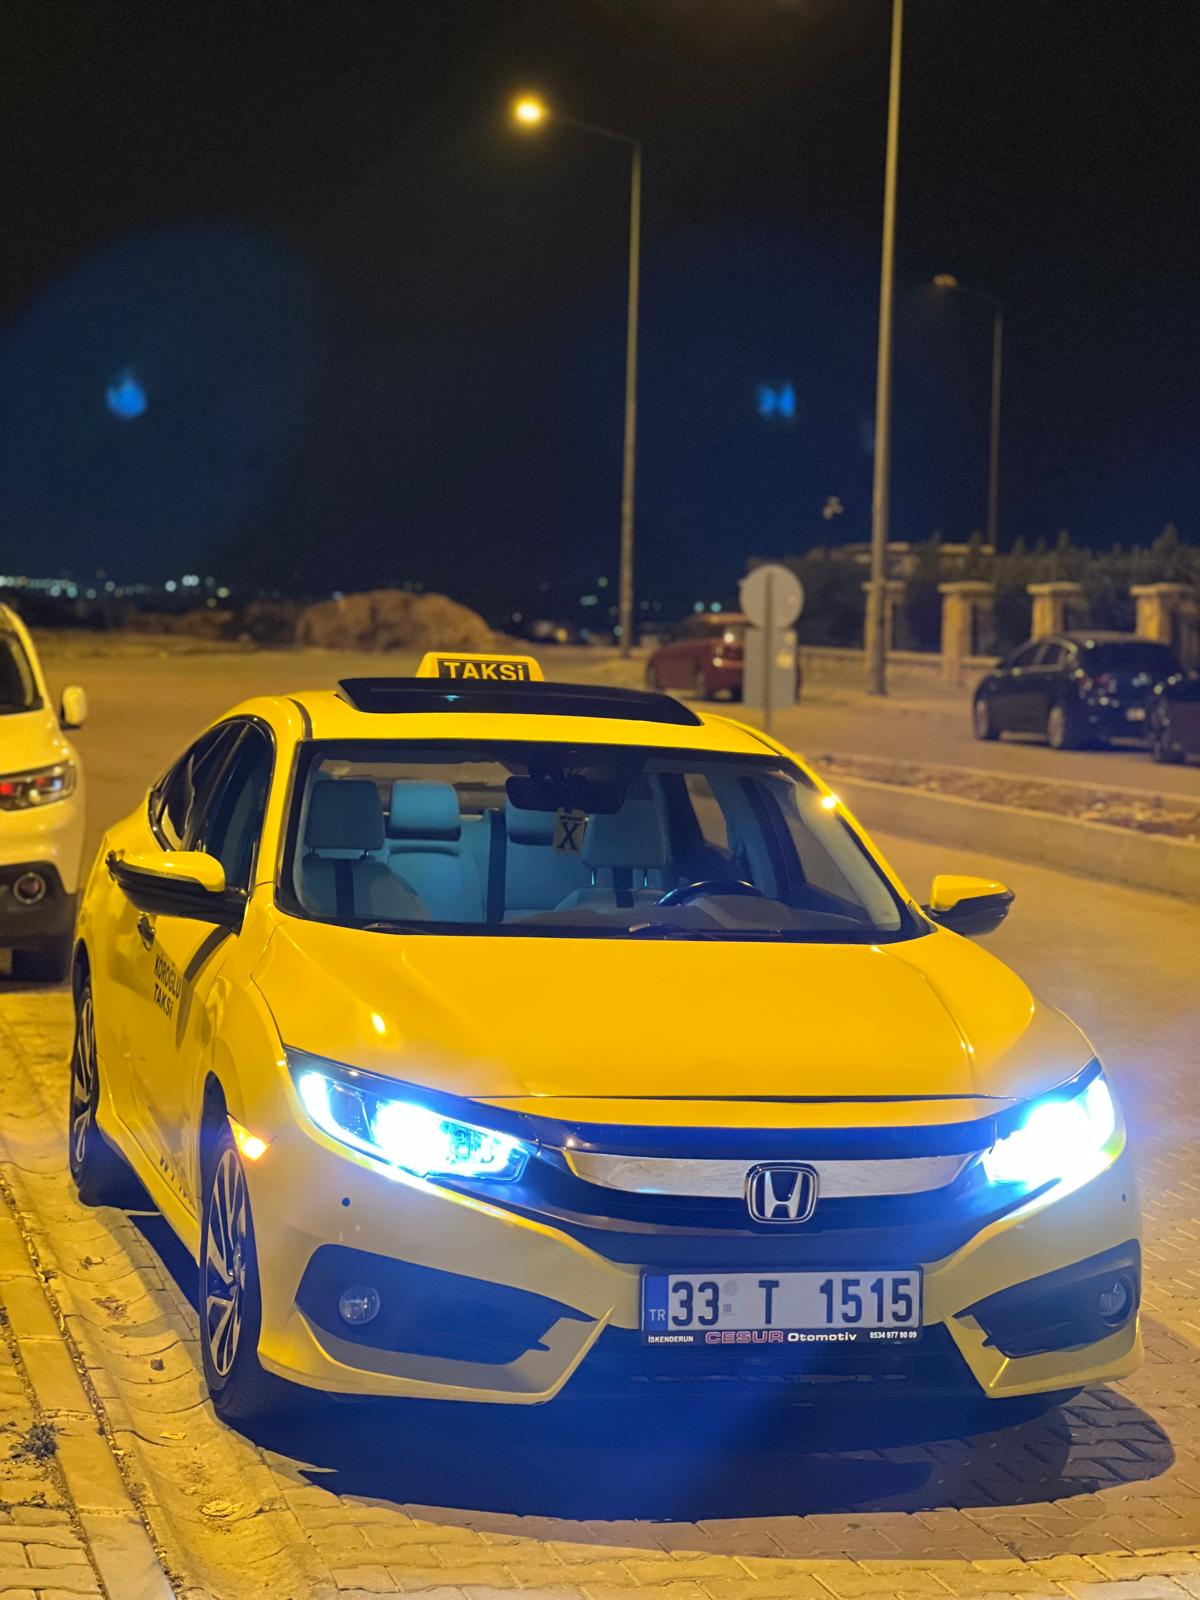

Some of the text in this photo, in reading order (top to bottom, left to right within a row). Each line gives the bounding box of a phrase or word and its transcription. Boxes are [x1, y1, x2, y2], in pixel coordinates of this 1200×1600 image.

[671, 1277, 913, 1327] 33 T 1515
[648, 1308, 667, 1322] TR
[704, 1330, 857, 1344] CESUR Otomotiv
